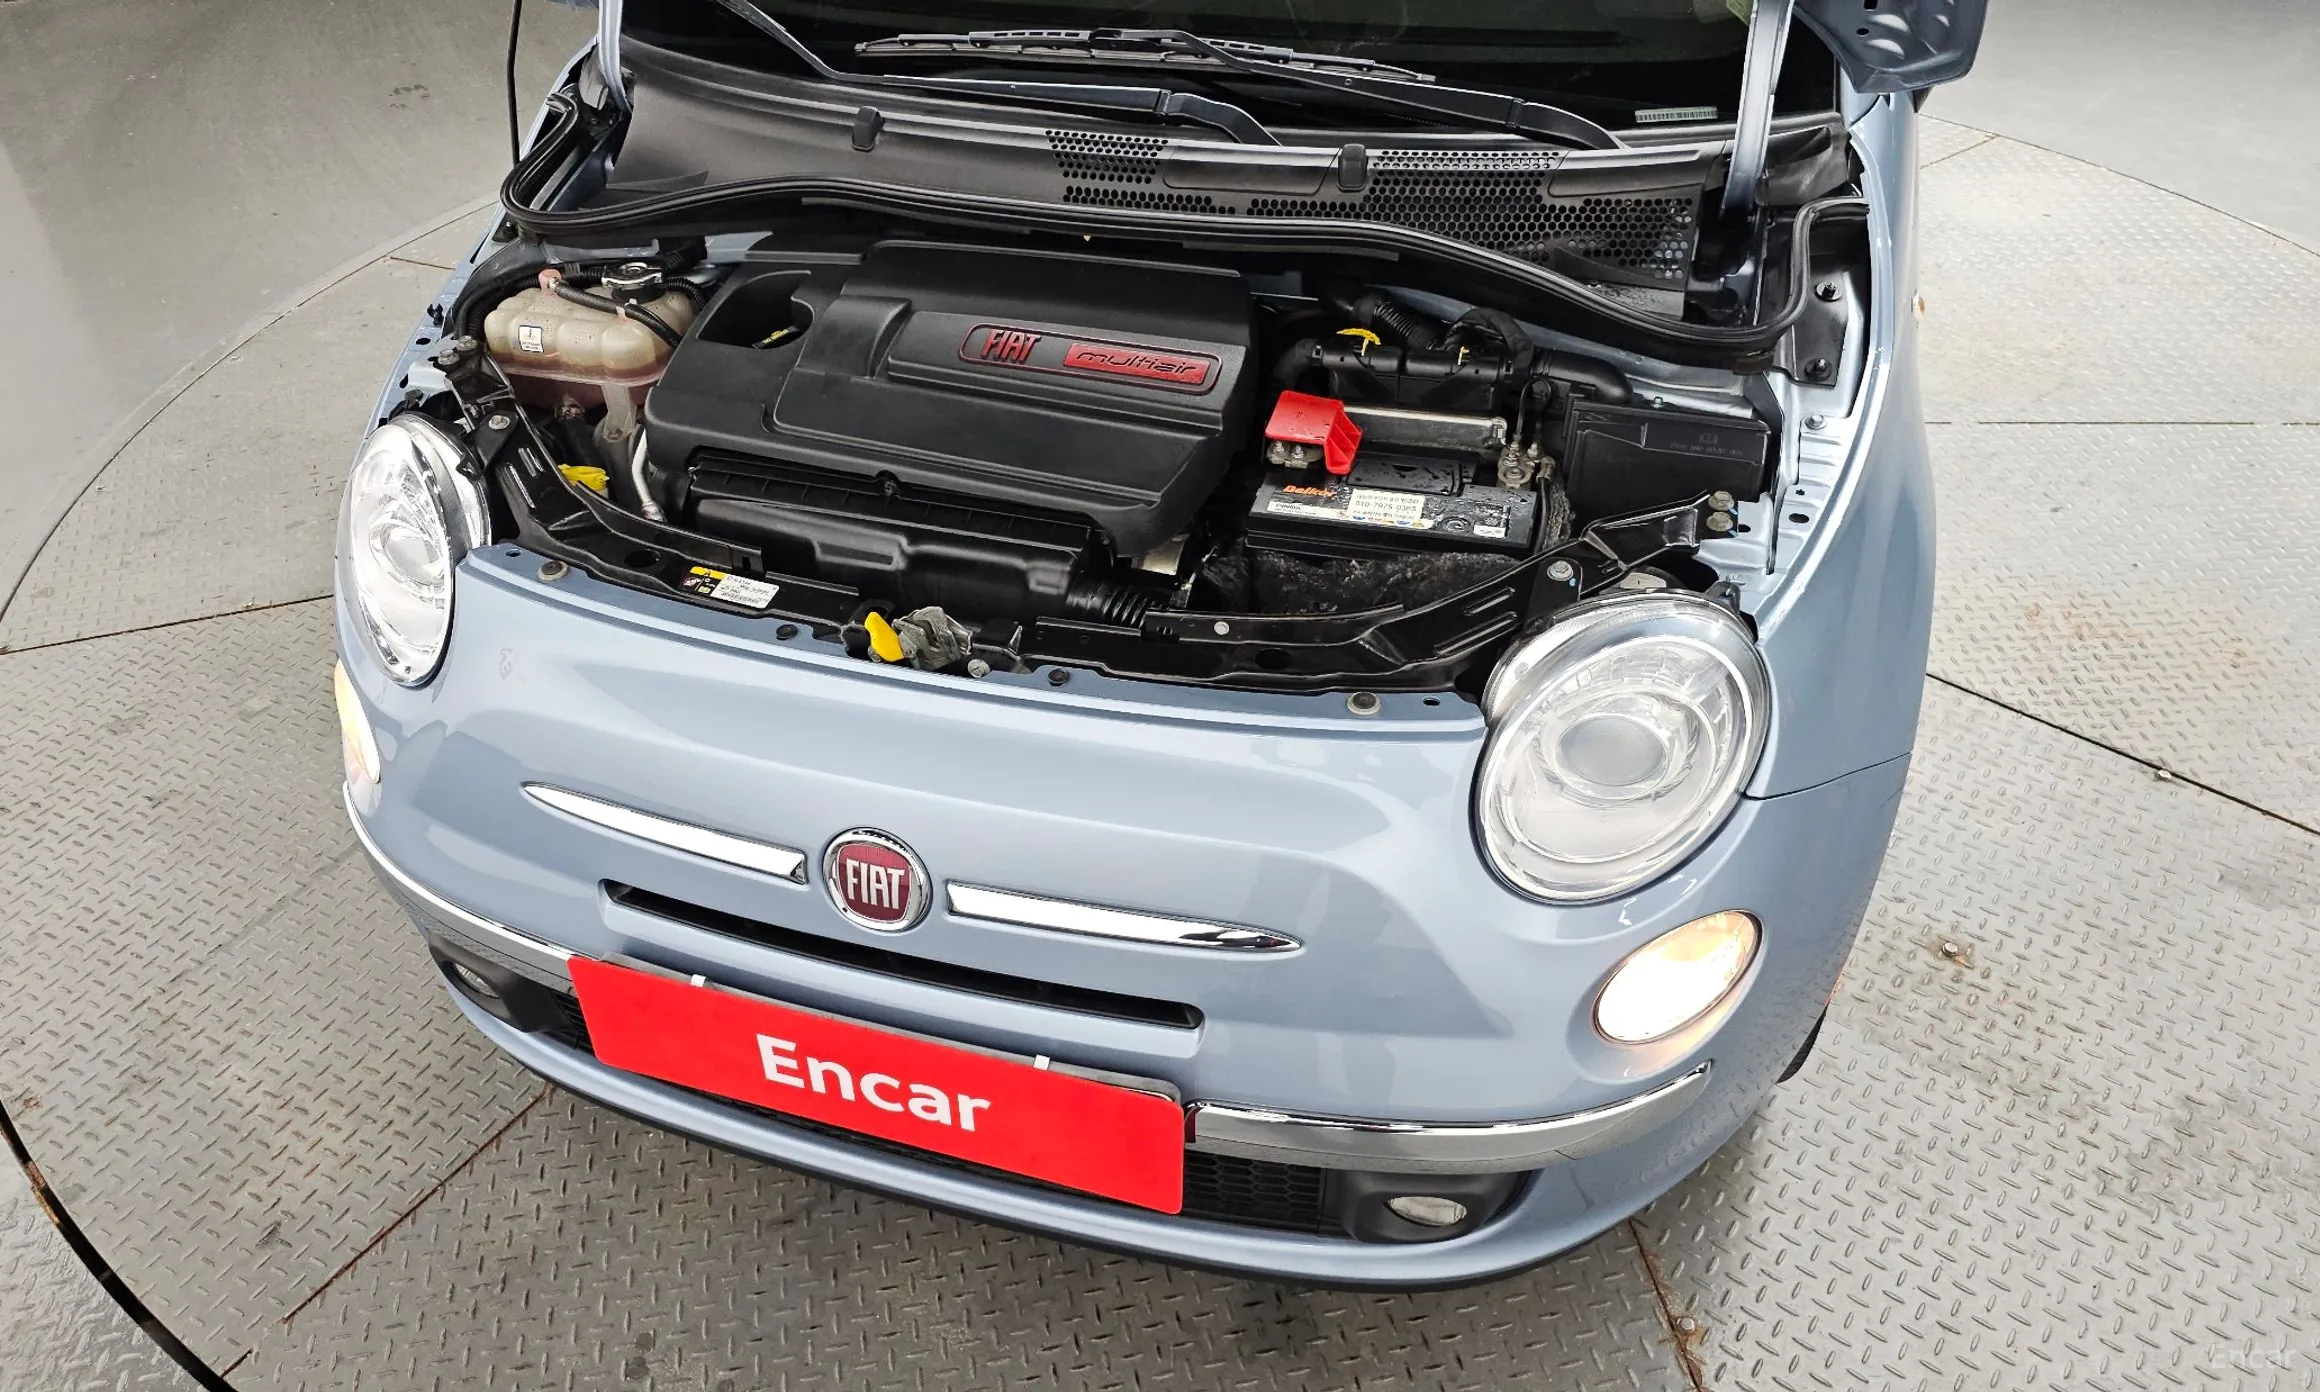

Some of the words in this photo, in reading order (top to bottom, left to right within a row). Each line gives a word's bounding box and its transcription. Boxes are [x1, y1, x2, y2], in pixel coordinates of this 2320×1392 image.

[981, 329, 1042, 363] FIAT
[1076, 352, 1198, 375] multiair
[846, 858, 905, 909] FIAT
[756, 1033, 991, 1132] Encar
